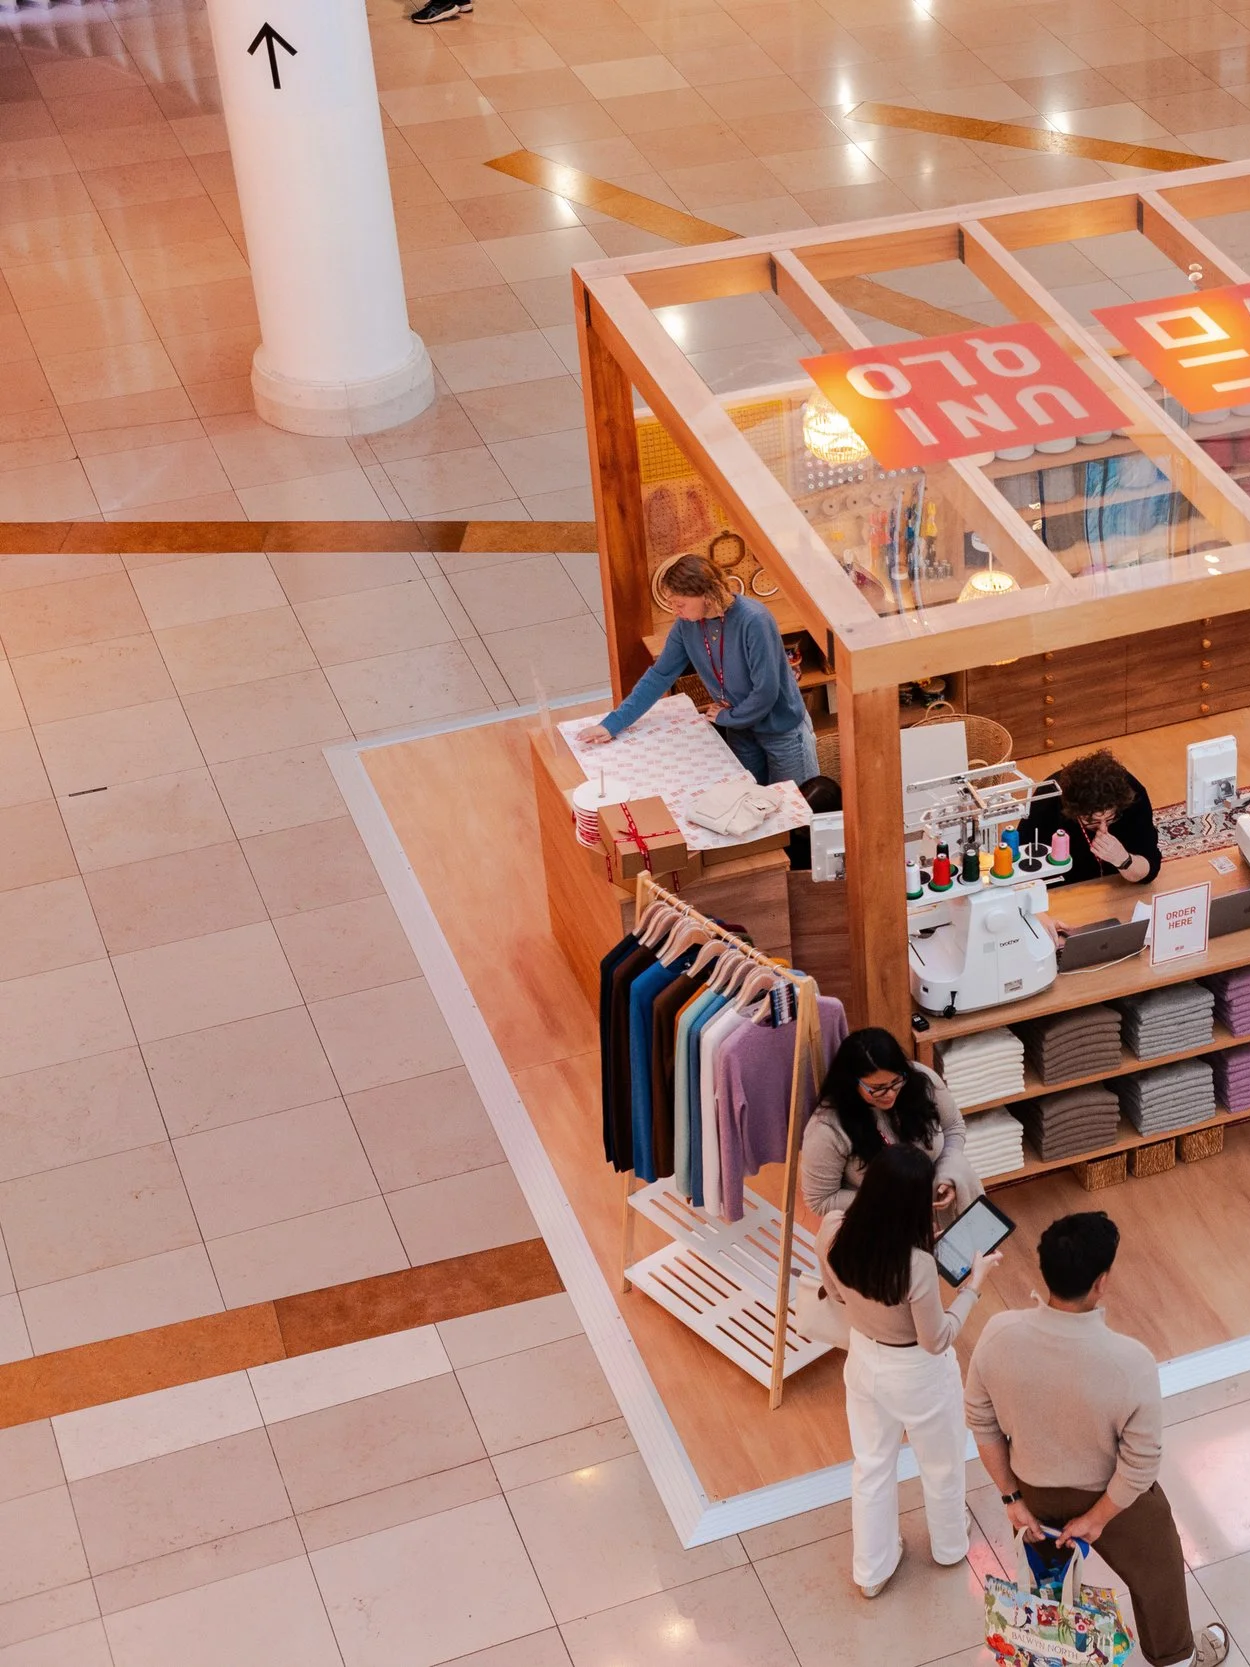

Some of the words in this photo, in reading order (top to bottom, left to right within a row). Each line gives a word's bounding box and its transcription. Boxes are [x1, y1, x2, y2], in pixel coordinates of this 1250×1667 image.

[846, 338, 1041, 400] QLO
[894, 384, 1090, 447] UNI
[1166, 906, 1196, 920] ORDER
[1168, 917, 1192, 929] HERE
[1011, 1632, 1045, 1649] BALWYN
[1047, 1643, 1078, 1660] NORTH
